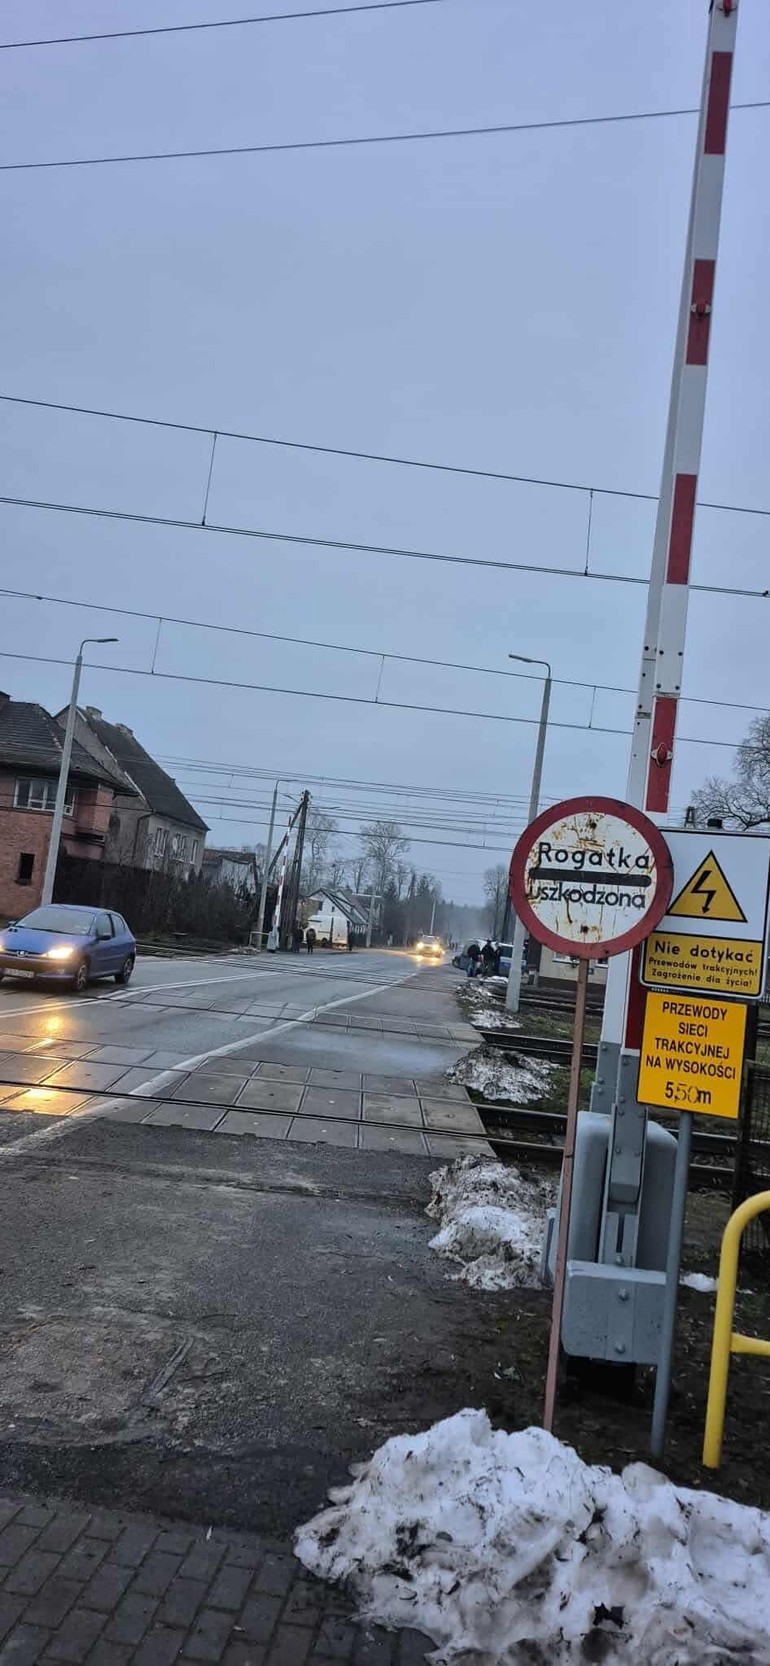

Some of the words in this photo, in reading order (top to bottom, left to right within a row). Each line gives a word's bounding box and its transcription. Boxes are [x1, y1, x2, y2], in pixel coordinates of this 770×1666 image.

[539, 842, 650, 869] Rogatka
[529, 882, 646, 908] uszkodzona
[655, 941, 681, 955] Nie
[690, 944, 754, 963] dotykać
[649, 957, 697, 969] Przewodów
[703, 963, 758, 976] trakcyjnych!
[652, 968, 701, 982] Zagrożenie
[706, 975, 721, 984] dla
[726, 976, 753, 989] życia!
[662, 1001, 728, 1021] PRZEWODY
[678, 1022, 708, 1038] SIECI
[655, 1037, 730, 1060] TRAKCYJNEJ
[646, 1055, 662, 1069] NA
[665, 1057, 736, 1080] WYSOKOŚCI
